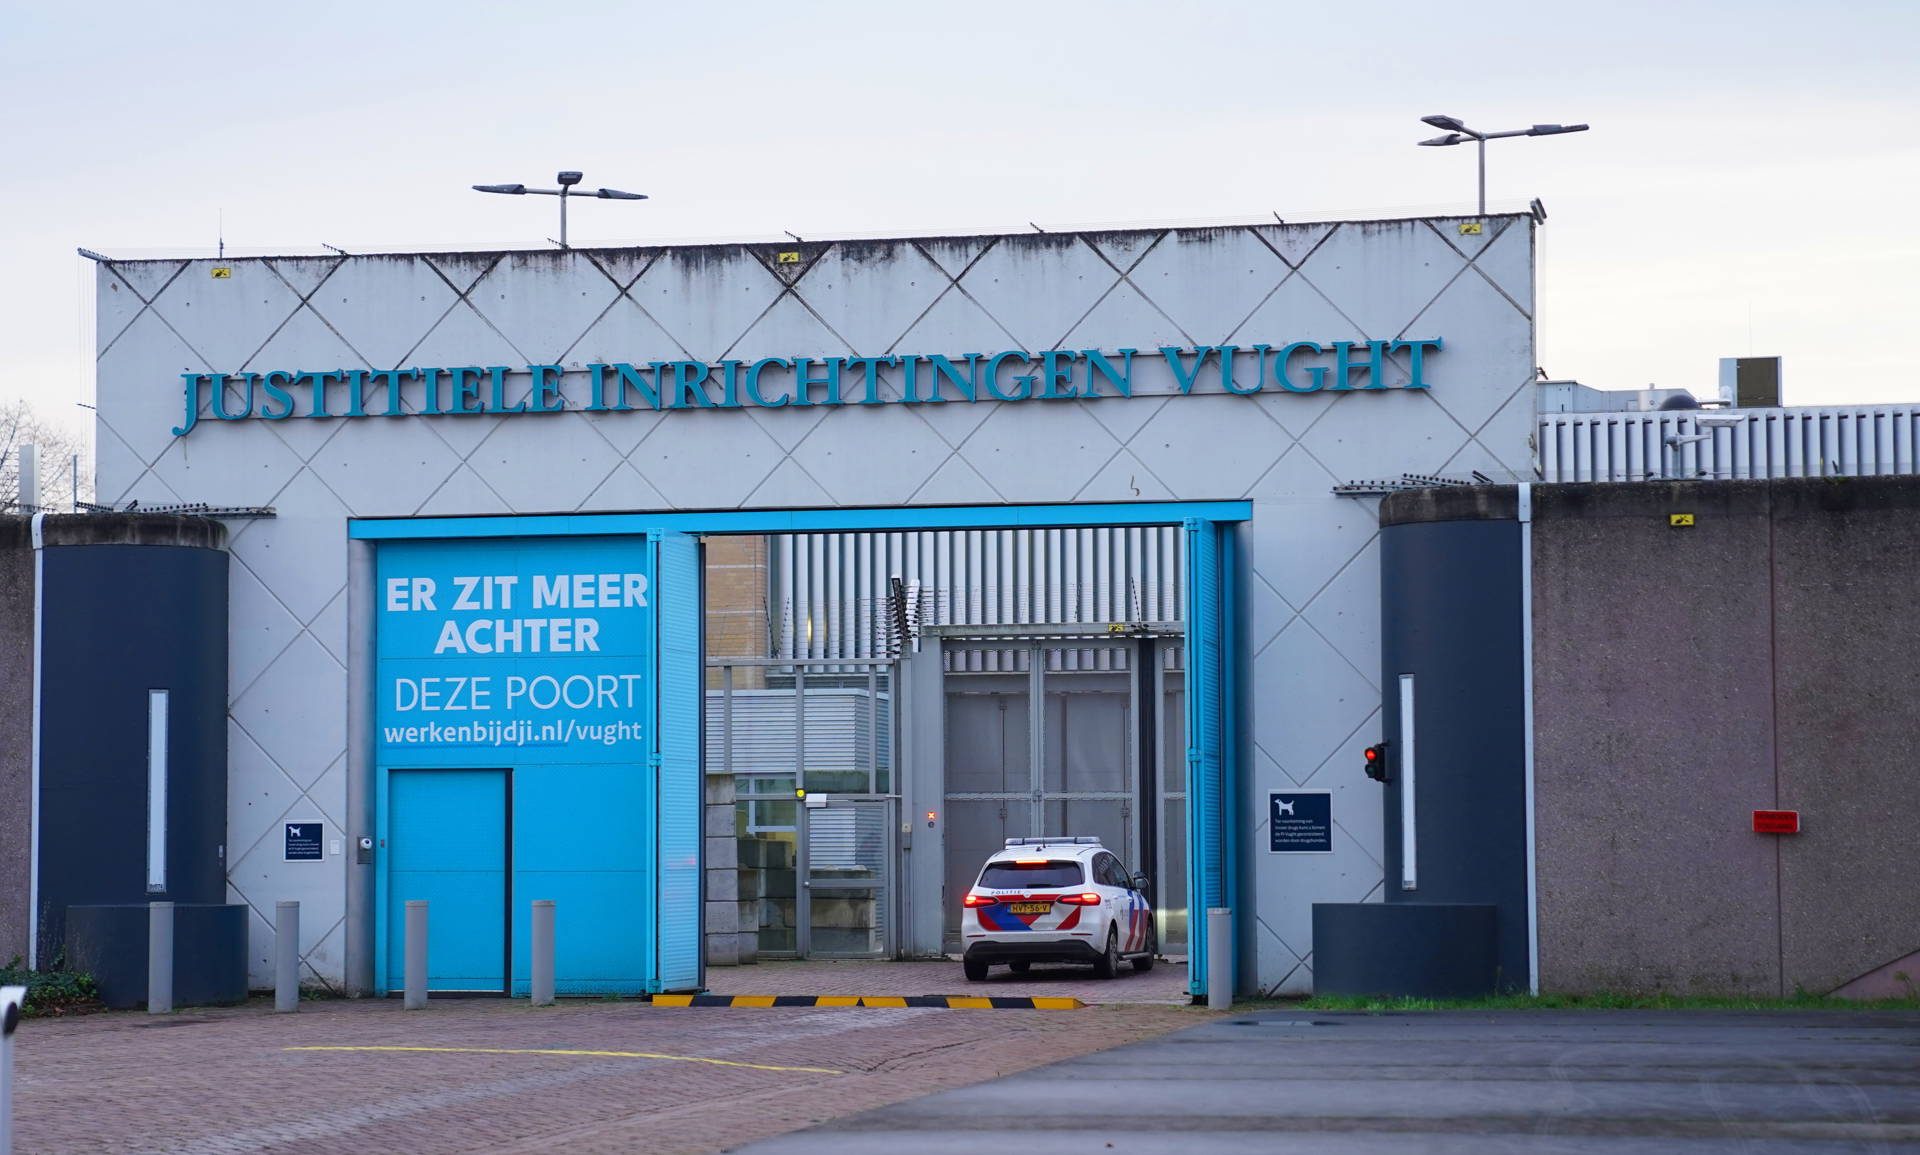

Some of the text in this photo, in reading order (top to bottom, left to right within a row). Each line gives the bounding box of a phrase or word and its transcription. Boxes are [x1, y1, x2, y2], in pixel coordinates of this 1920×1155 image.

[172, 336, 1443, 437] JUSTITIELE INRICHTINGEN VUGHT
[386, 573, 648, 612] ER ZIT MEER
[433, 617, 601, 654] ACHTER
[395, 674, 641, 712] DEZE POORT
[384, 719, 642, 747] werkenbijdji.nl/vught
